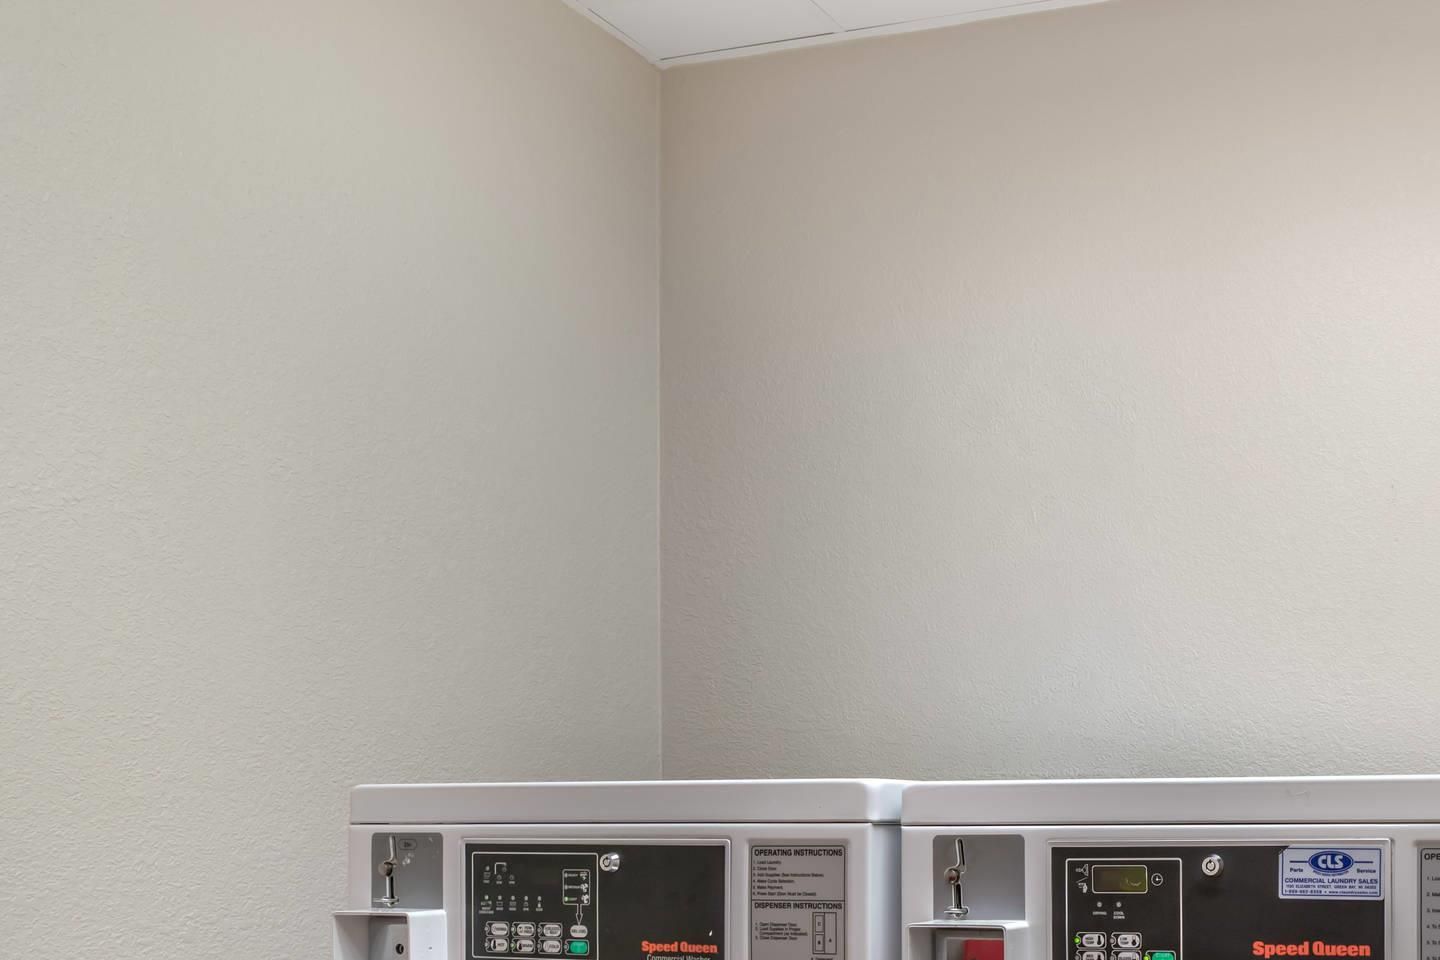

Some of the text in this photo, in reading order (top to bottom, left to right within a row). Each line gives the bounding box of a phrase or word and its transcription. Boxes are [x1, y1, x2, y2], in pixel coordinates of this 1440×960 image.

[754, 849, 843, 857] OPERATING INSTRUCTIONS
[1317, 855, 1344, 869] CLS
[754, 902, 843, 910] DISPENSER INSTRUCTIONS
[641, 940, 718, 954] Speed Queen
[1252, 940, 1371, 959] Speed Queen
